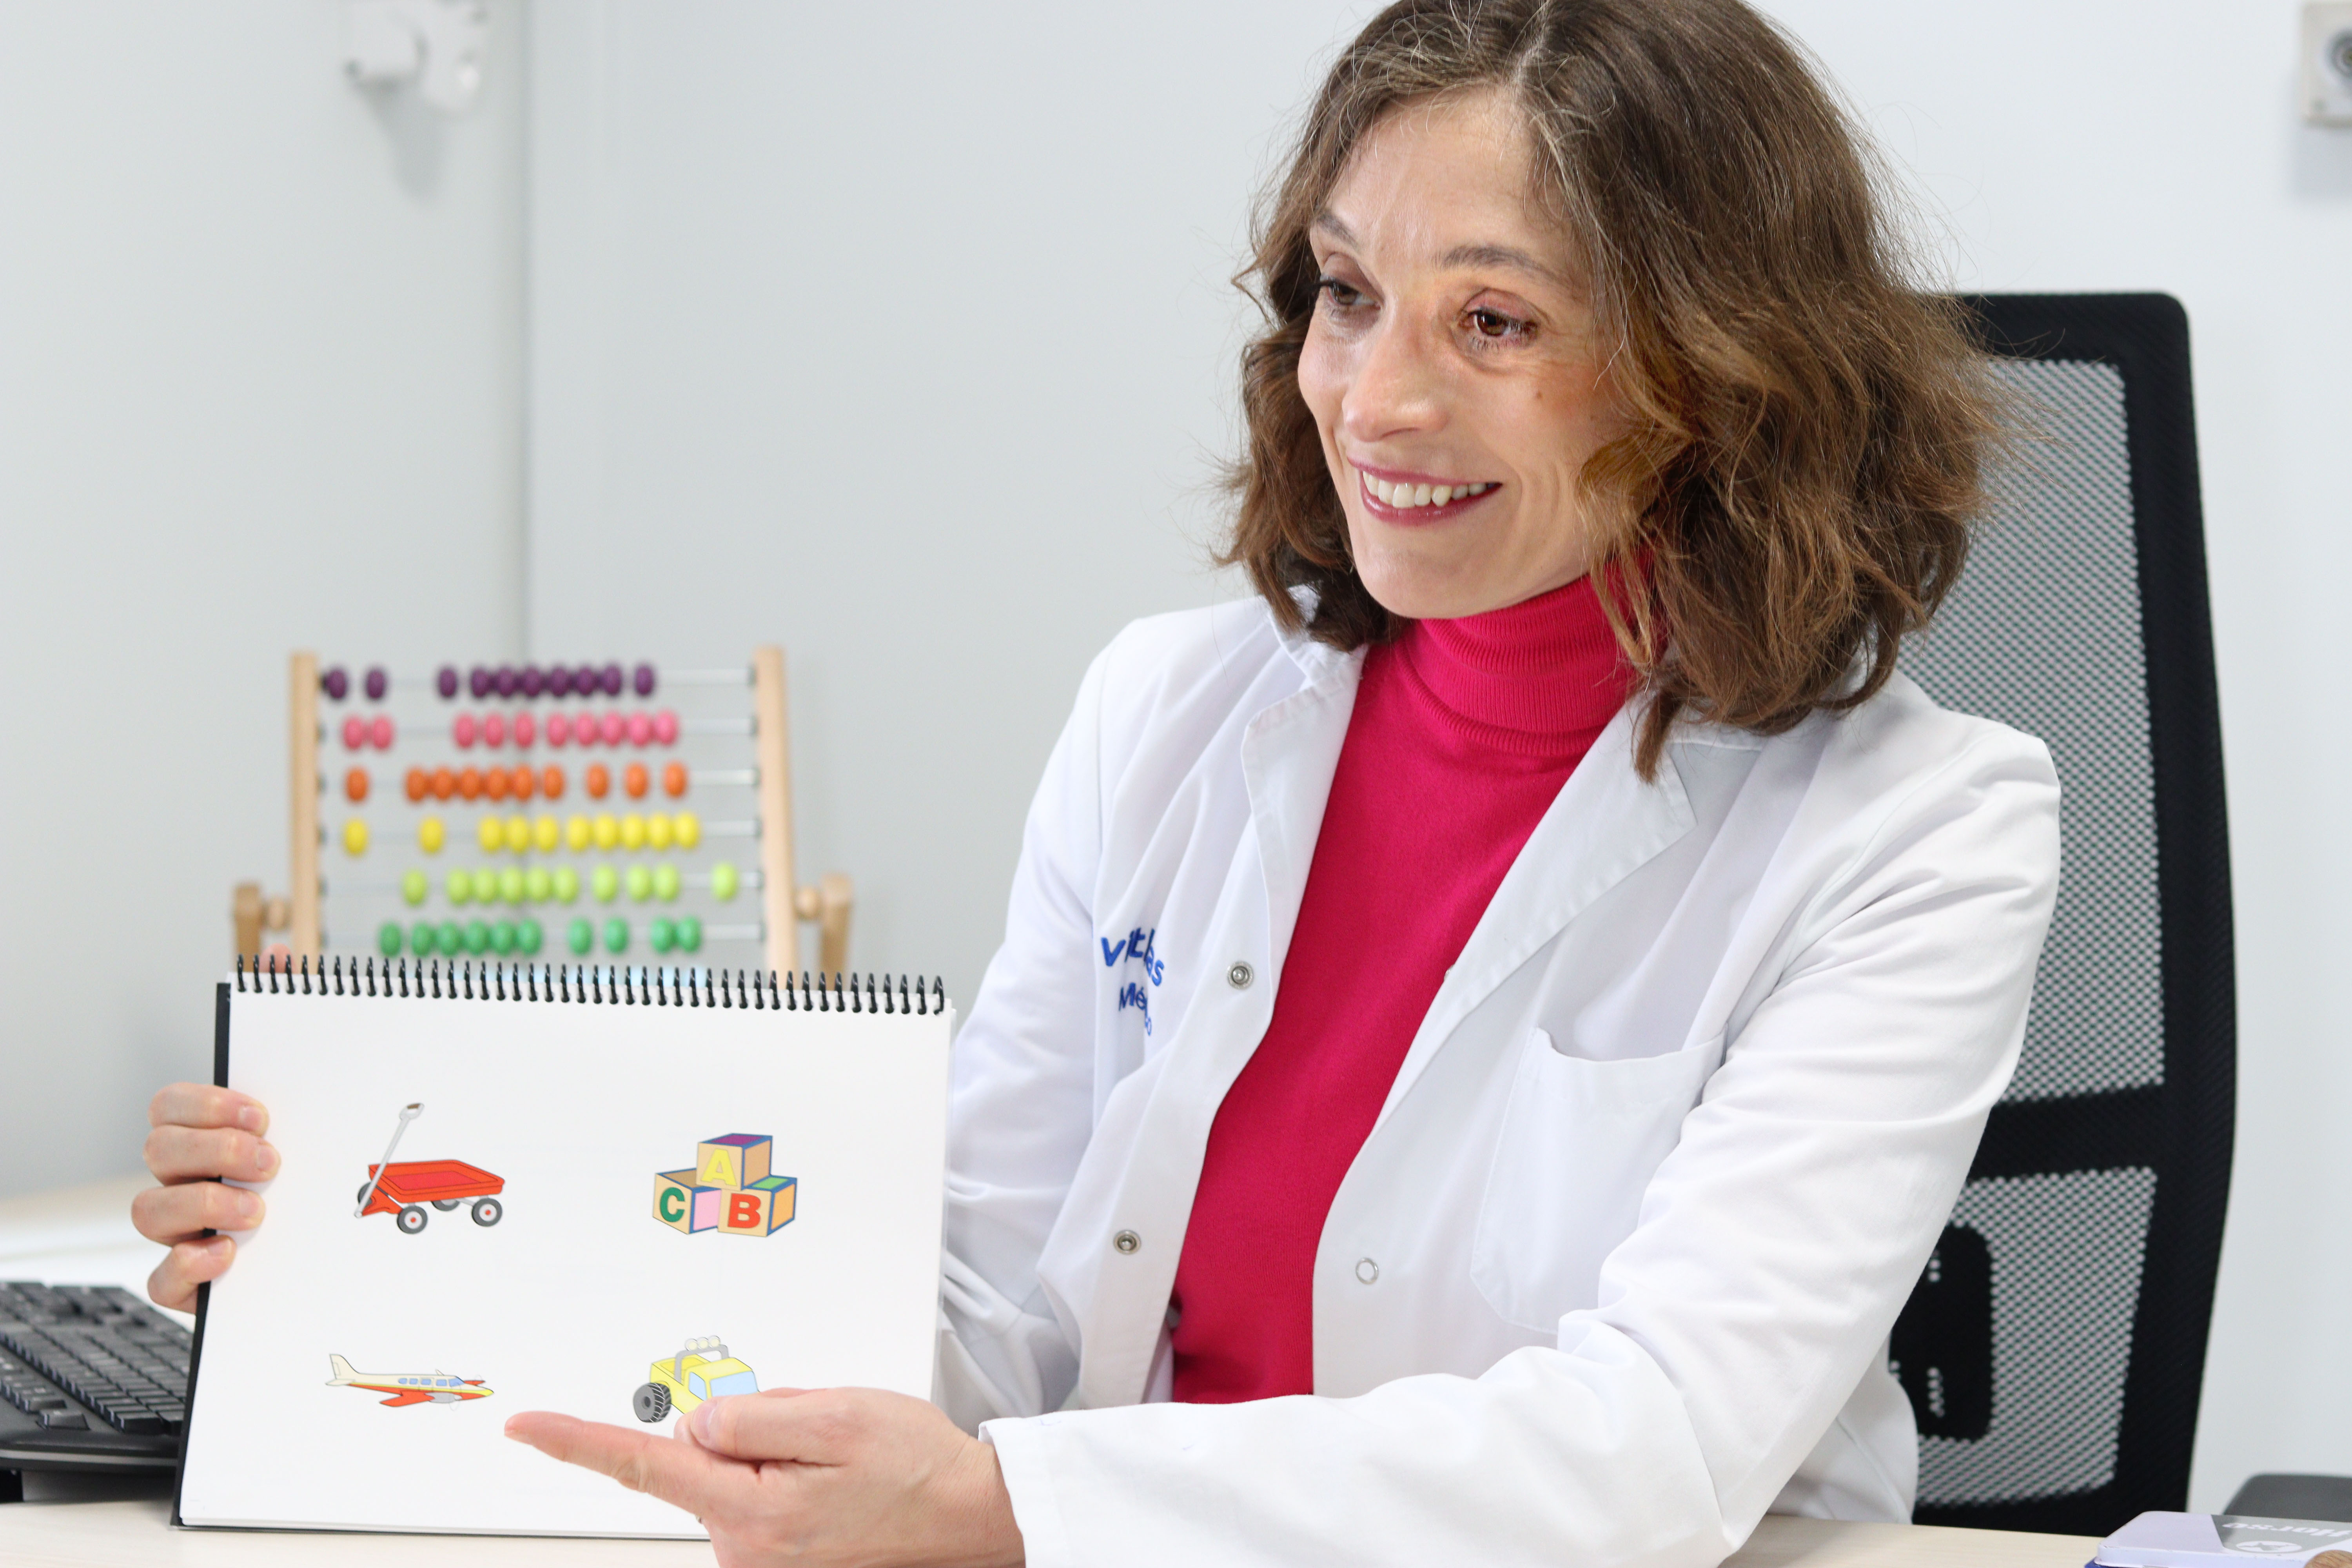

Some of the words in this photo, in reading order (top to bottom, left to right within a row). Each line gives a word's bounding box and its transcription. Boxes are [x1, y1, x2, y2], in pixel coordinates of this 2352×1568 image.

[701, 1148, 737, 1186] A
[659, 1187, 685, 1223] C
[727, 1193, 761, 1229] B
